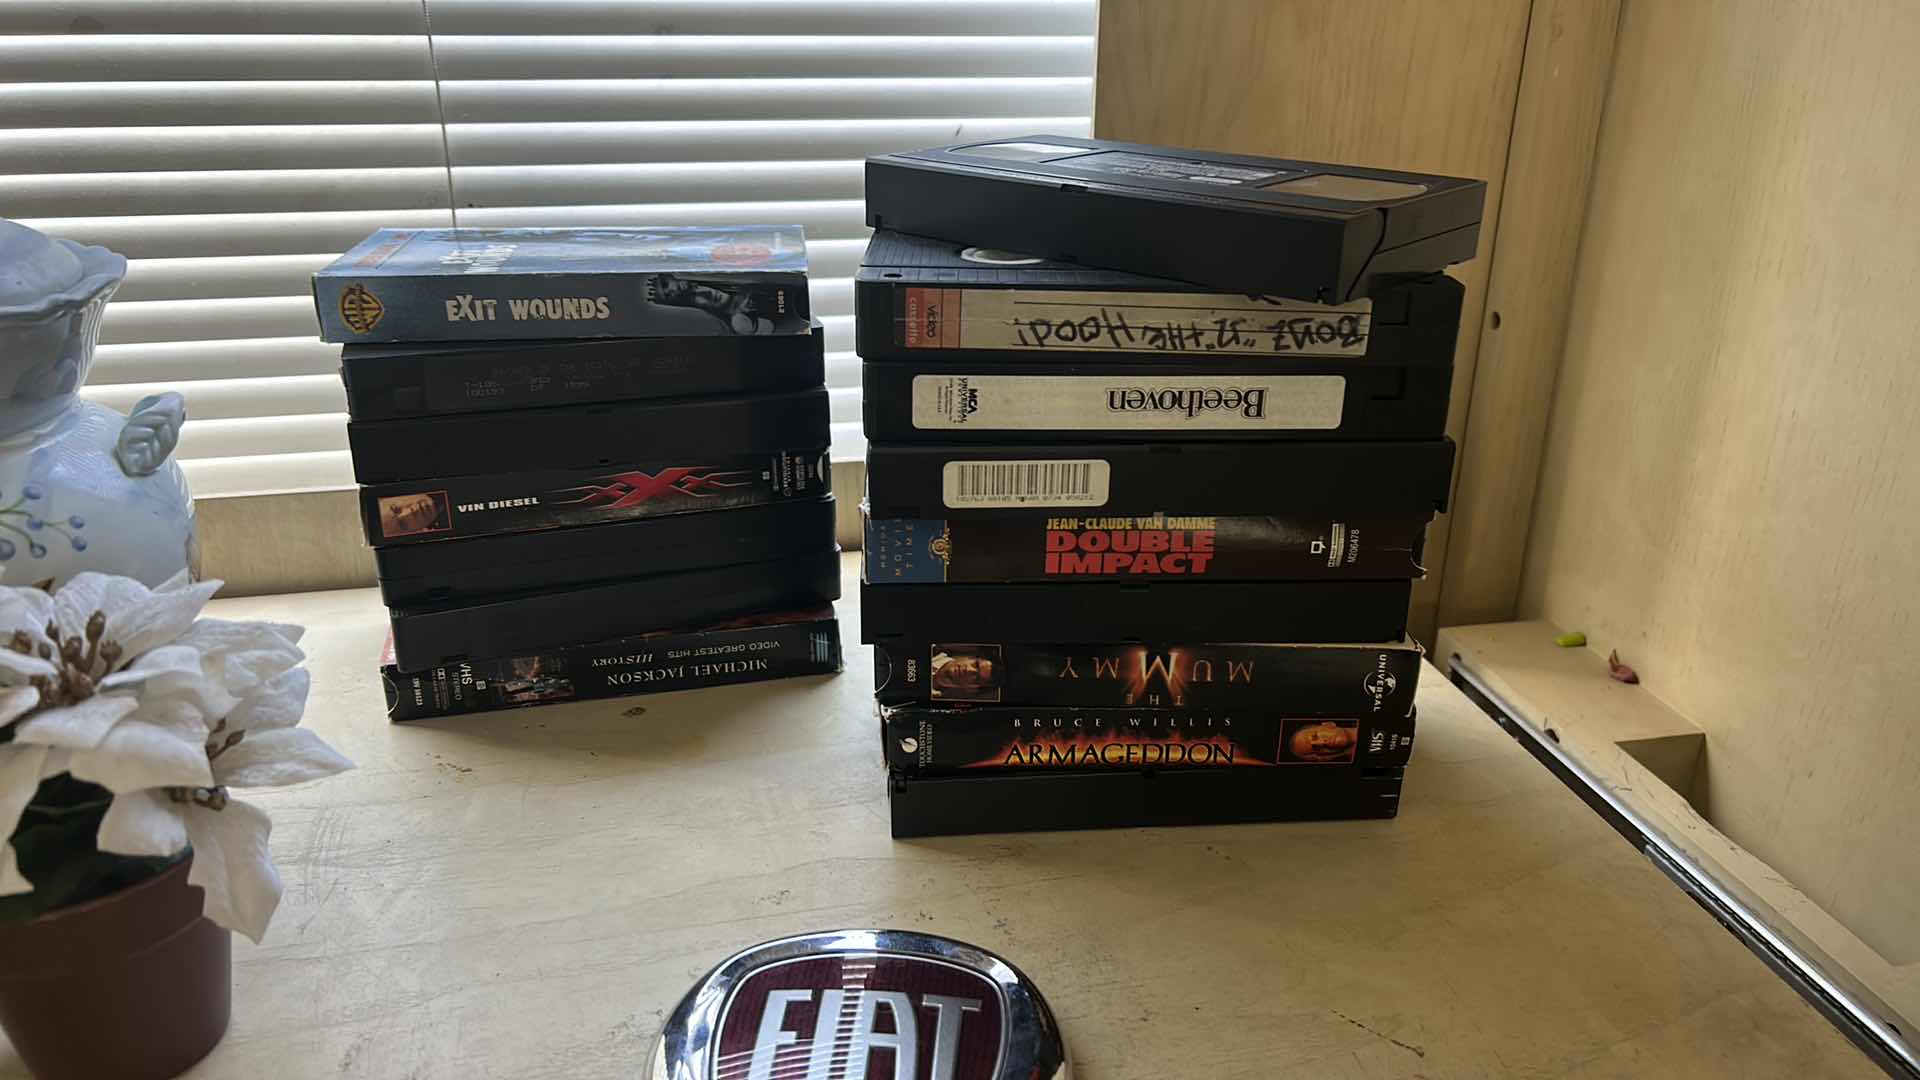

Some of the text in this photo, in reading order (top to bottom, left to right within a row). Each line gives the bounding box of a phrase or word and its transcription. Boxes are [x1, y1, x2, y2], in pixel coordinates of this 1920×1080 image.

[446, 294, 611, 322] EXIT WOUNDS
[967, 388, 979, 414] MCA
[1107, 385, 1268, 421] Beethoven
[457, 496, 541, 514] VIN DIESEL
[1046, 516, 1216, 530] JEAN-CLAUDE VAN DAMME
[1045, 529, 1217, 553] DOUBLE
[1044, 552, 1214, 574] IMPACT
[667, 648, 691, 660] HITS
[693, 643, 746, 657] GREATEST
[748, 639, 781, 652] VIDEO
[458, 662, 474, 686] VHS
[606, 658, 769, 687] MICHAEL JACKSON
[1056, 651, 1255, 687] MUMMY
[1372, 653, 1388, 713] UNIVERSAL
[1125, 694, 1184, 706] THE
[1014, 717, 1232, 728] BRUCE WILLIS
[1368, 731, 1385, 752] VHS
[1004, 743, 1235, 765] ARMAGEDDON
[749, 989, 983, 1080] FIAT
